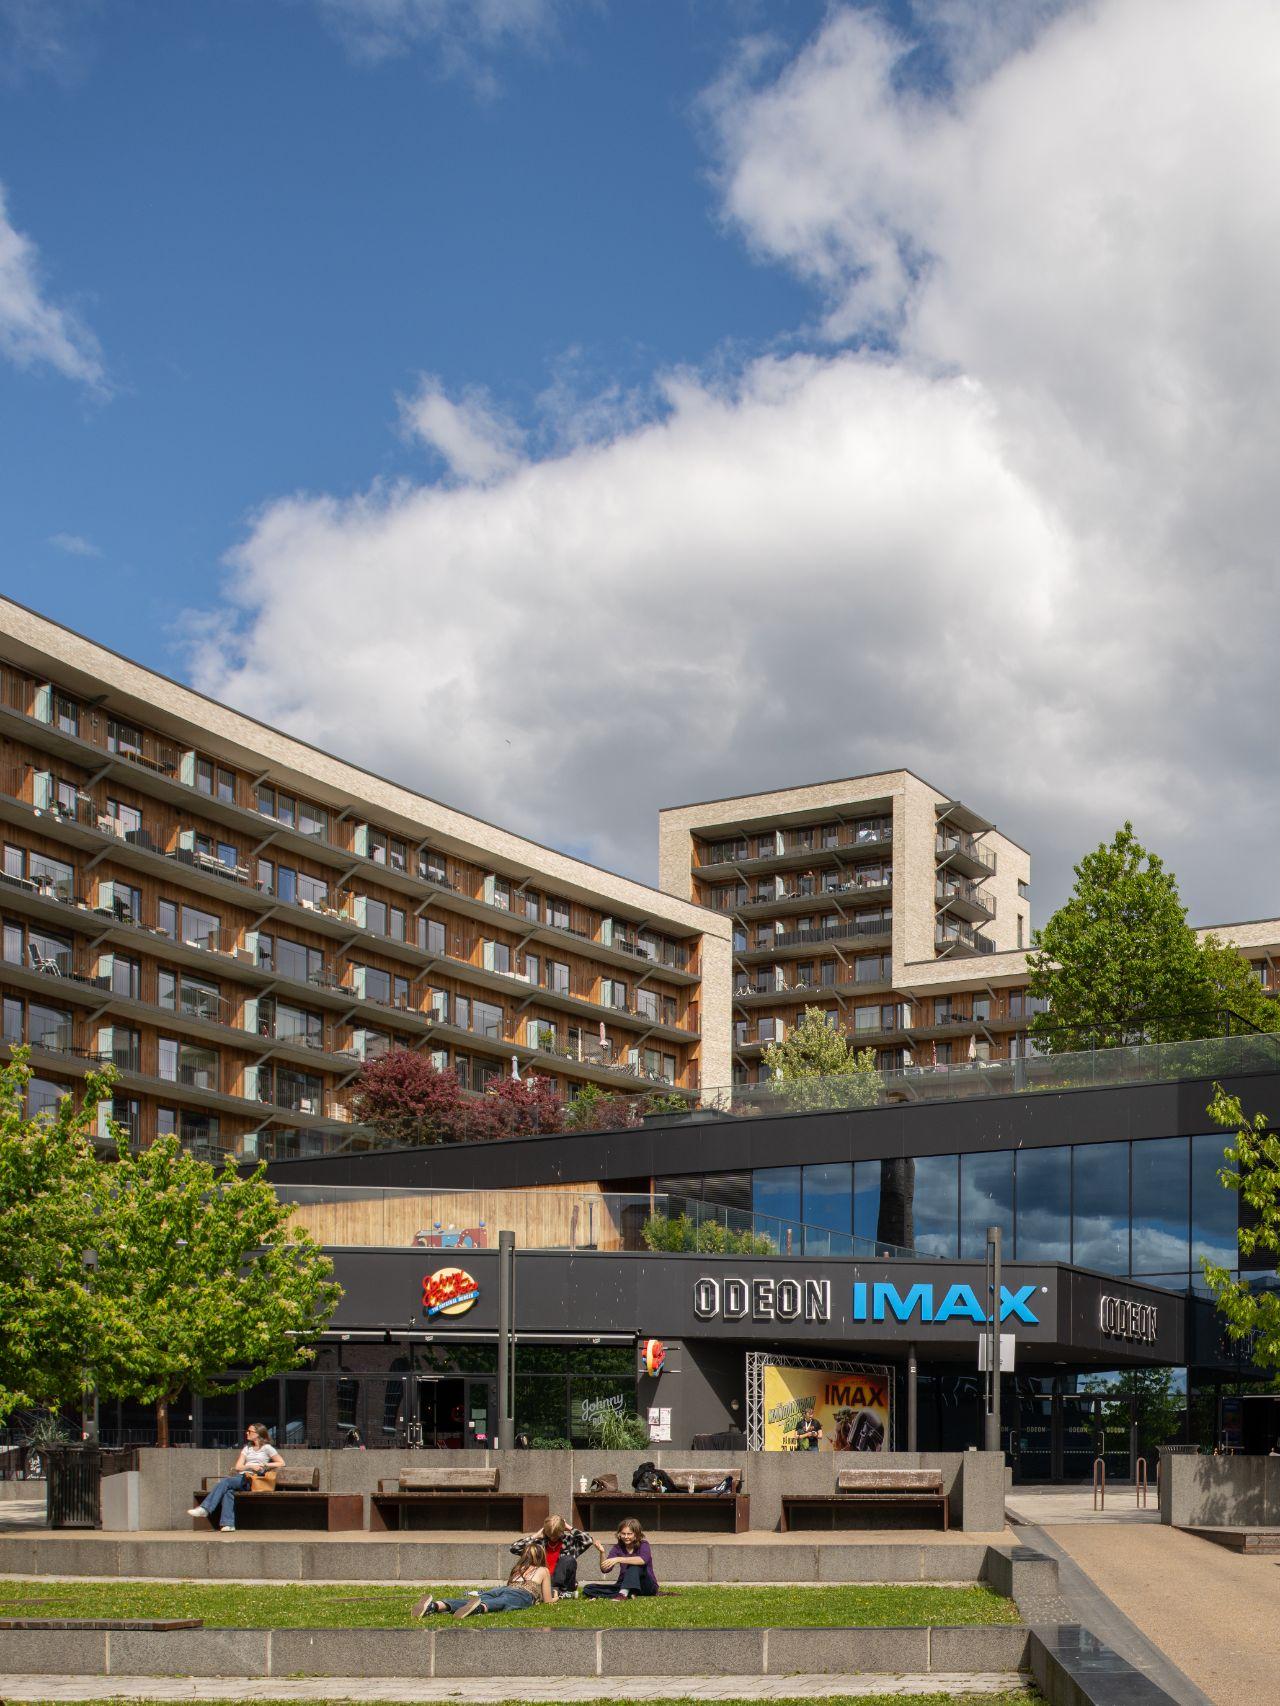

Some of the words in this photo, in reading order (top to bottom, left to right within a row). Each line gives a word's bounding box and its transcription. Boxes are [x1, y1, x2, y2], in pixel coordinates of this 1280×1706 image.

[694, 1277, 831, 1320] ODEON
[853, 1281, 1040, 1323] IMAX
[1100, 1295, 1158, 1341] ODEON
[581, 1394, 624, 1421] Johnny
[824, 1383, 884, 1407] IMAX
